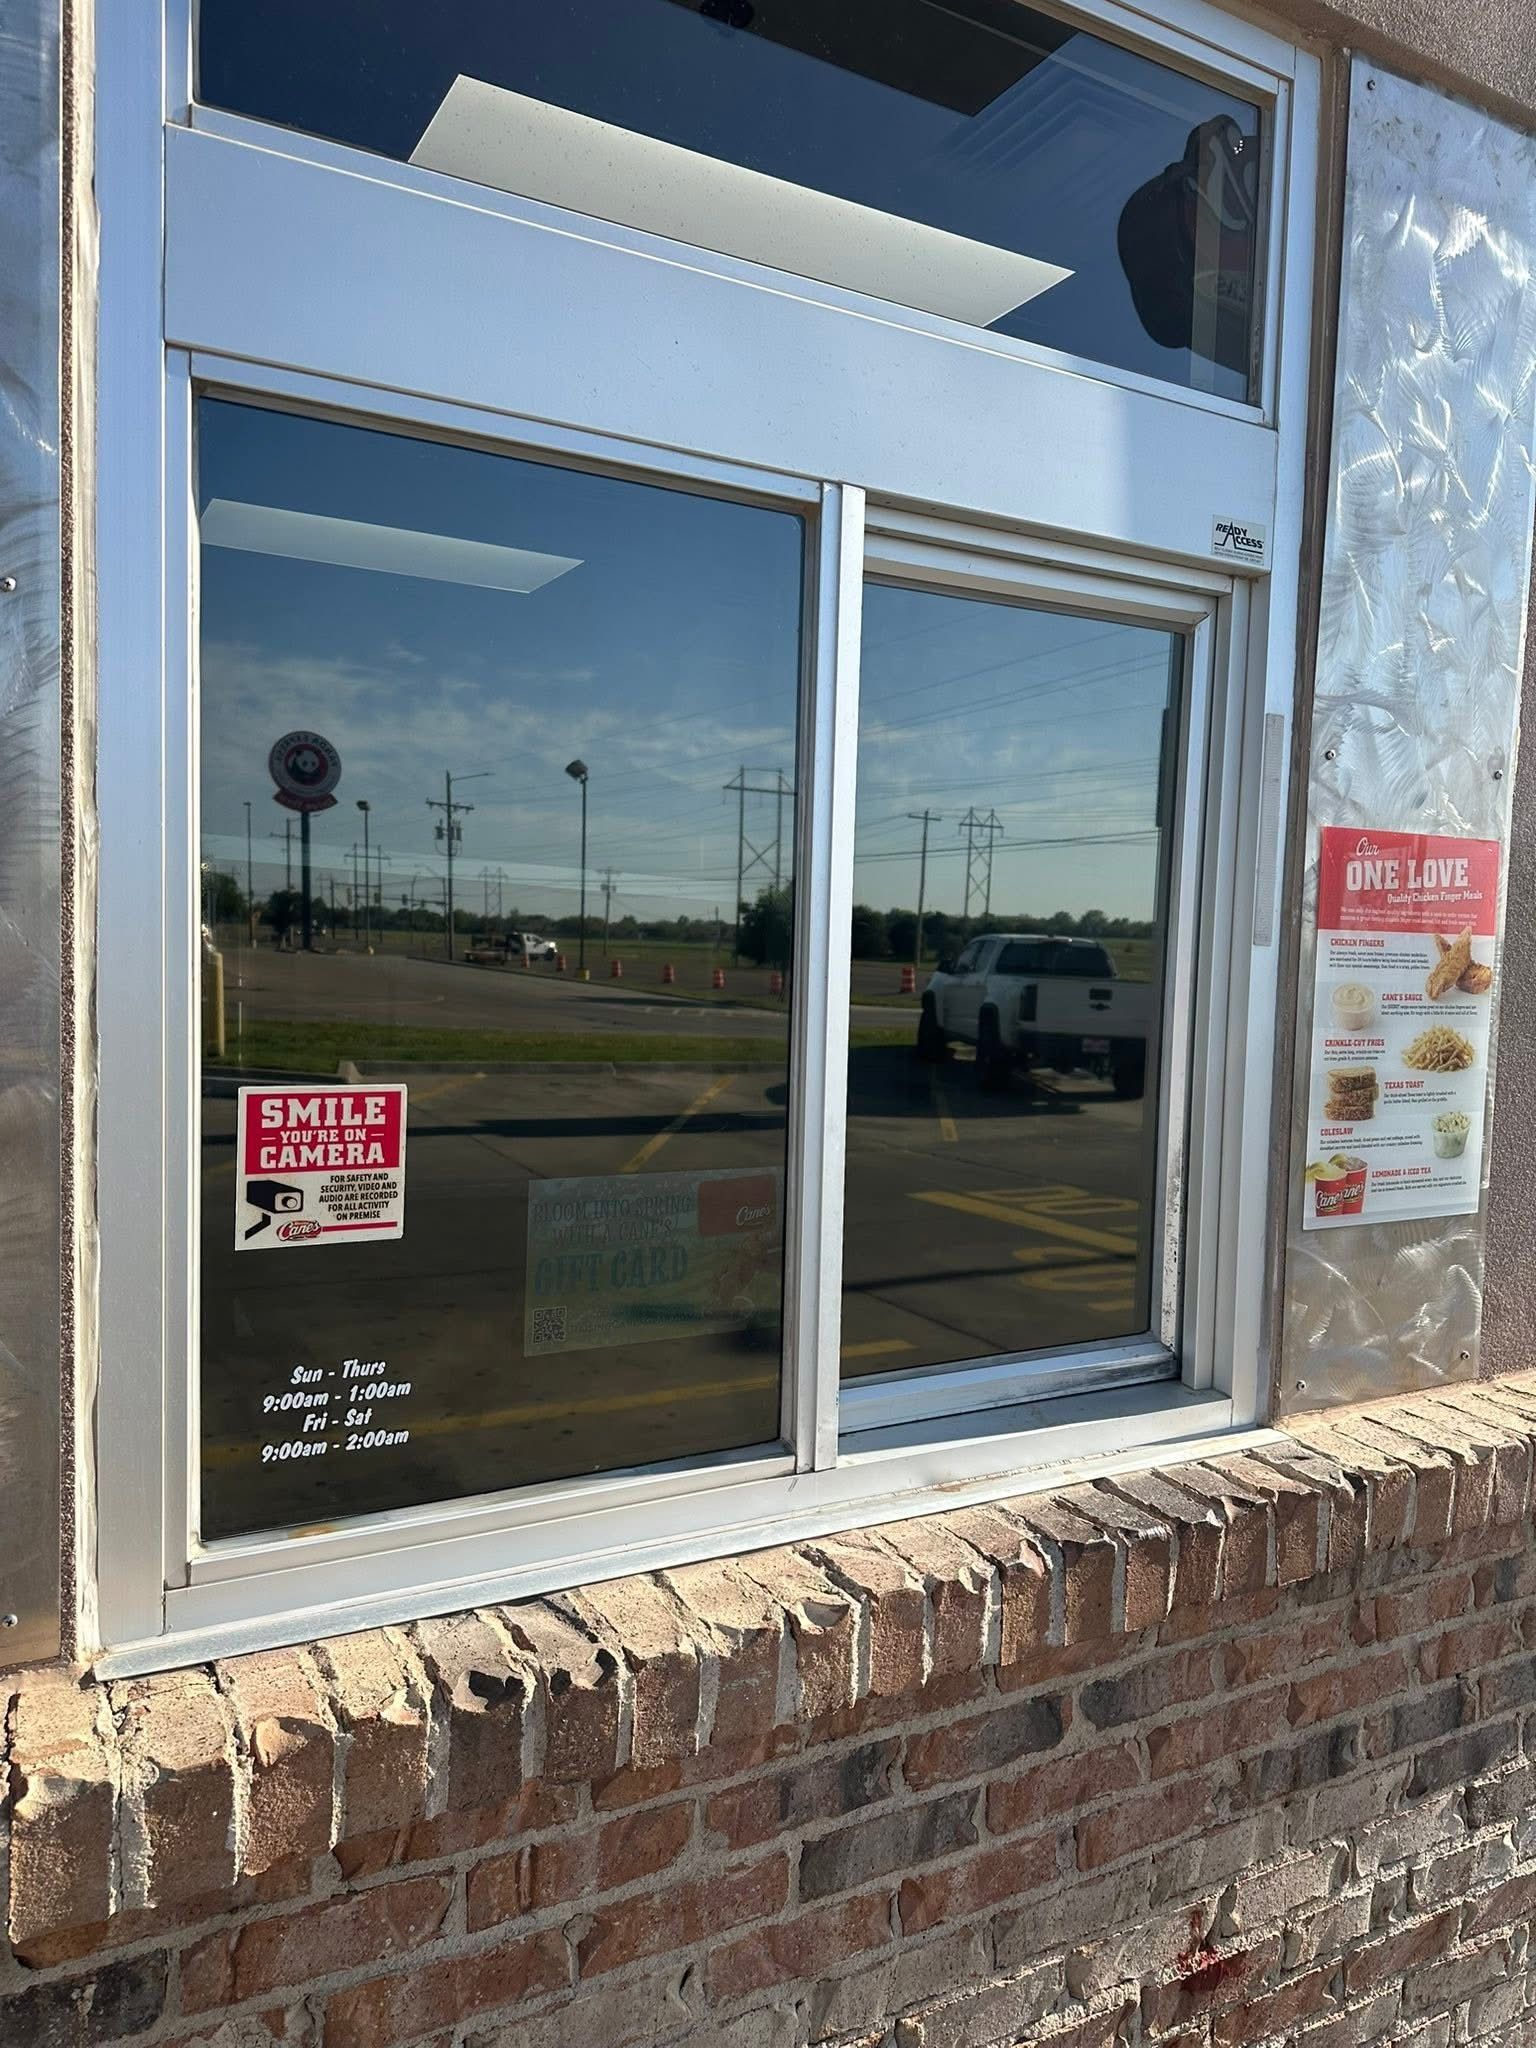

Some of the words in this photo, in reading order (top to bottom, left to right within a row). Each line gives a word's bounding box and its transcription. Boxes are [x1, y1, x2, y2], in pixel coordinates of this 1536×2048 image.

[1215, 521, 1248, 538] READY
[1356, 837, 1380, 856] Our
[1346, 859, 1399, 891] ONE
[1407, 858, 1469, 889] LOVE
[1387, 893, 1412, 905] Quality
[1412, 892, 1440, 903] Chicken
[1440, 891, 1462, 903] Finger
[1463, 890, 1483, 900] Meals
[1330, 938, 1358, 947] CHICKEN
[1359, 939, 1385, 947] FINGERS
[1382, 993, 1403, 1001] CANE'S
[1404, 993, 1423, 1001] SAUCE
[1367, 1038, 1385, 1047] FRIES
[1384, 1081, 1404, 1090] TEXAS
[1405, 1080, 1424, 1089] TOAST
[261, 1096, 387, 1128] SMILE
[280, 1129, 339, 1144] YOU'RE
[344, 1128, 367, 1141] ON
[1320, 1127, 1354, 1137] COLESLAW
[260, 1142, 385, 1169] CAMERA
[330, 1174, 346, 1184] FOR
[346, 1173, 372, 1182] SAFETY
[372, 1172, 389, 1181] AND
[1371, 1169, 1402, 1179] LEMONADE
[1407, 1167, 1421, 1177] ICED
[1421, 1166, 1432, 1175] TEA
[320, 1184, 357, 1193] SECURITY,
[358, 1182, 380, 1191] VIDEO
[381, 1181, 397, 1190] AND
[319, 1194, 343, 1203] AUDIO
[344, 1192, 359, 1201] ARE
[360, 1191, 399, 1201] RECORDED
[328, 1203, 343, 1212] FOR
[344, 1202, 357, 1211] ALL
[357, 1200, 390, 1210] ACTIVITY
[336, 1212, 348, 1221] ON
[349, 1210, 381, 1220] PREMISE
[735, 1206, 770, 1226] Cane's
[610, 1247, 689, 1289] CARD
[290, 1366, 323, 1385] Sun
[342, 1359, 386, 1379] Thurs
[263, 1391, 329, 1413] 9:00am
[350, 1381, 411, 1402] 1:00am
[303, 1412, 328, 1433] Fri
[344, 1408, 372, 1427] Sat
[262, 1441, 328, 1463] 9:00am
[345, 1430, 409, 1451] 2:00am
